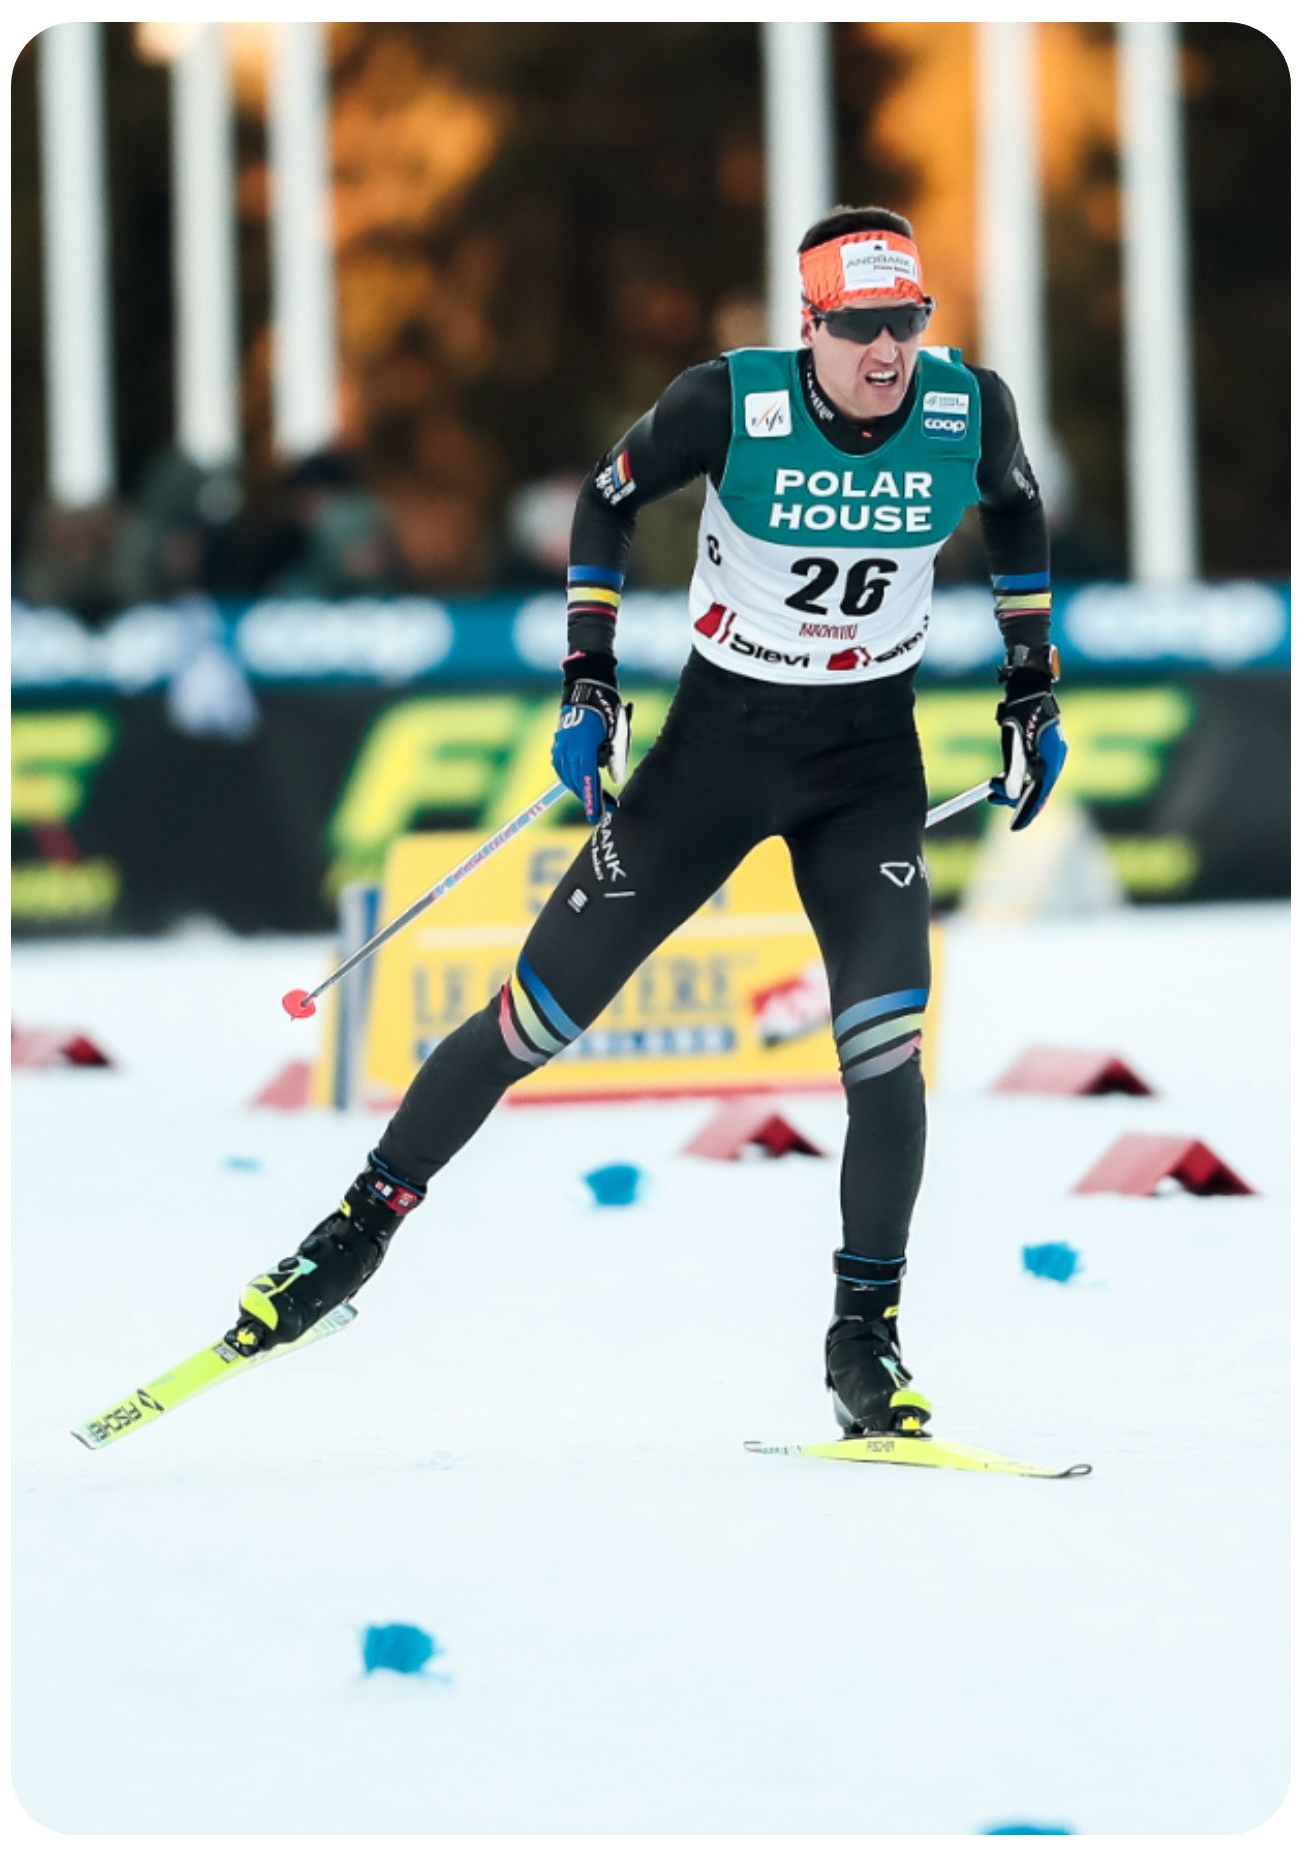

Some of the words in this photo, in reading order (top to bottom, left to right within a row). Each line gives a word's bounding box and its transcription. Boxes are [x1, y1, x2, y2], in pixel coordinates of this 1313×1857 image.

[923, 417, 966, 433] coop
[773, 468, 933, 499] POLAR
[769, 502, 933, 533] HOUSE
[785, 556, 899, 617] 26
